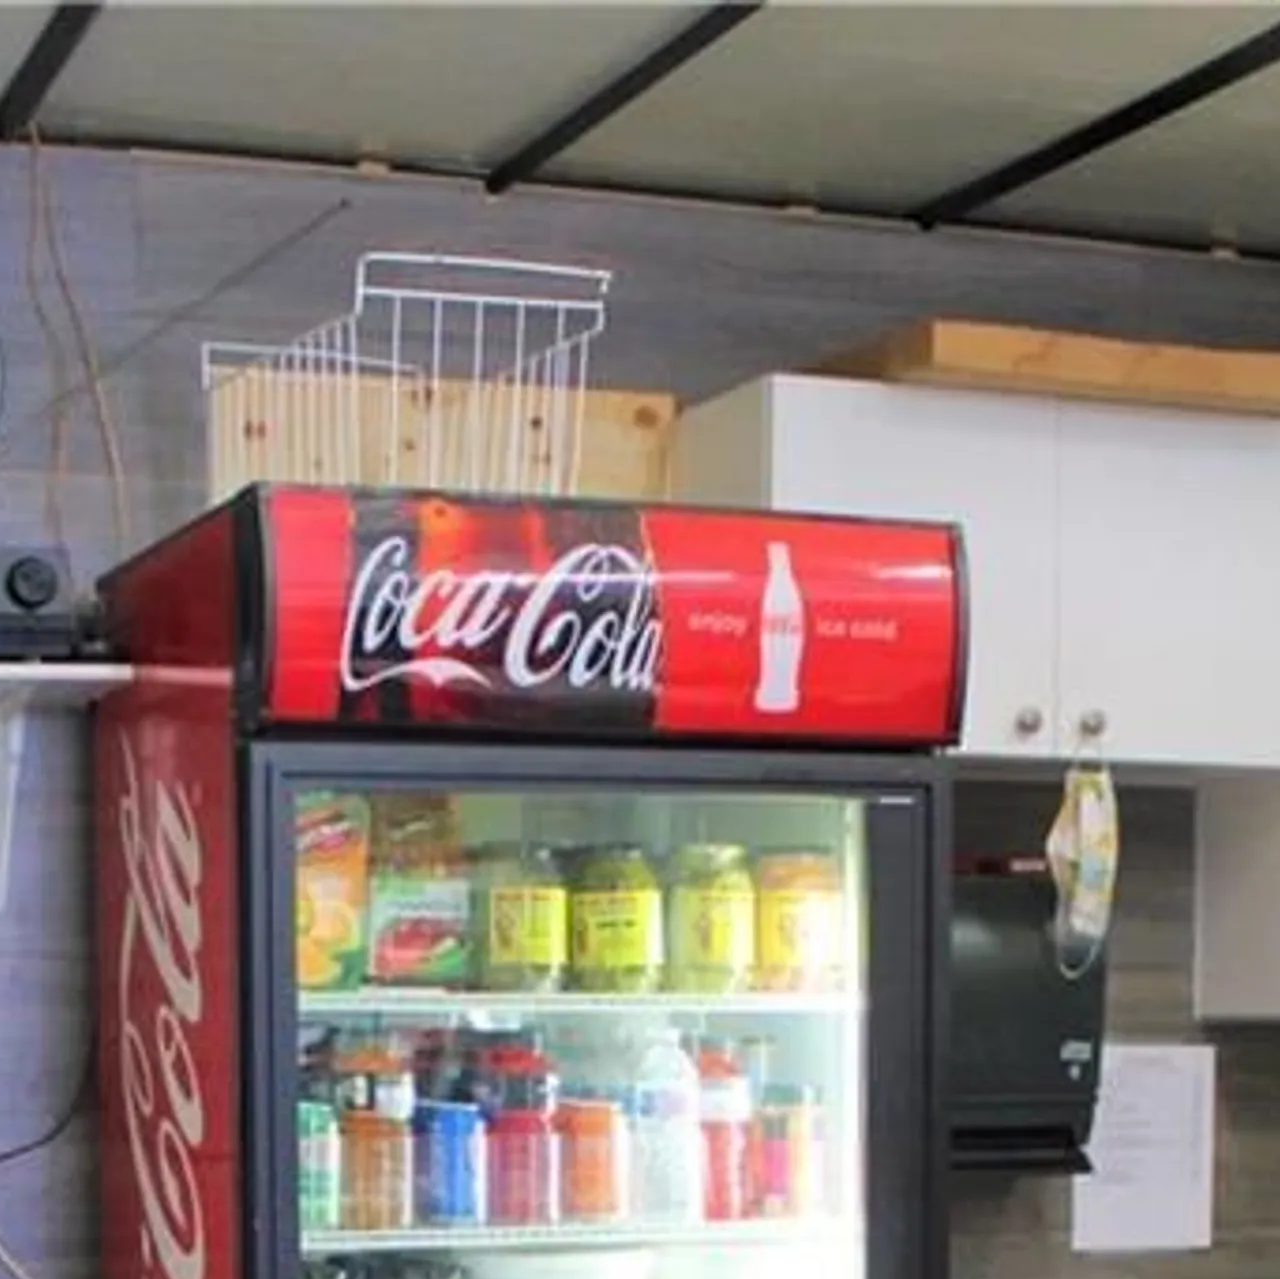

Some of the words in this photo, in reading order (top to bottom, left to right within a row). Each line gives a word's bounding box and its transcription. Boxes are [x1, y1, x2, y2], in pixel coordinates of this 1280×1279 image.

[686, 608, 748, 639] enjoy
[815, 615, 848, 637] ice
[850, 617, 898, 642] cold
